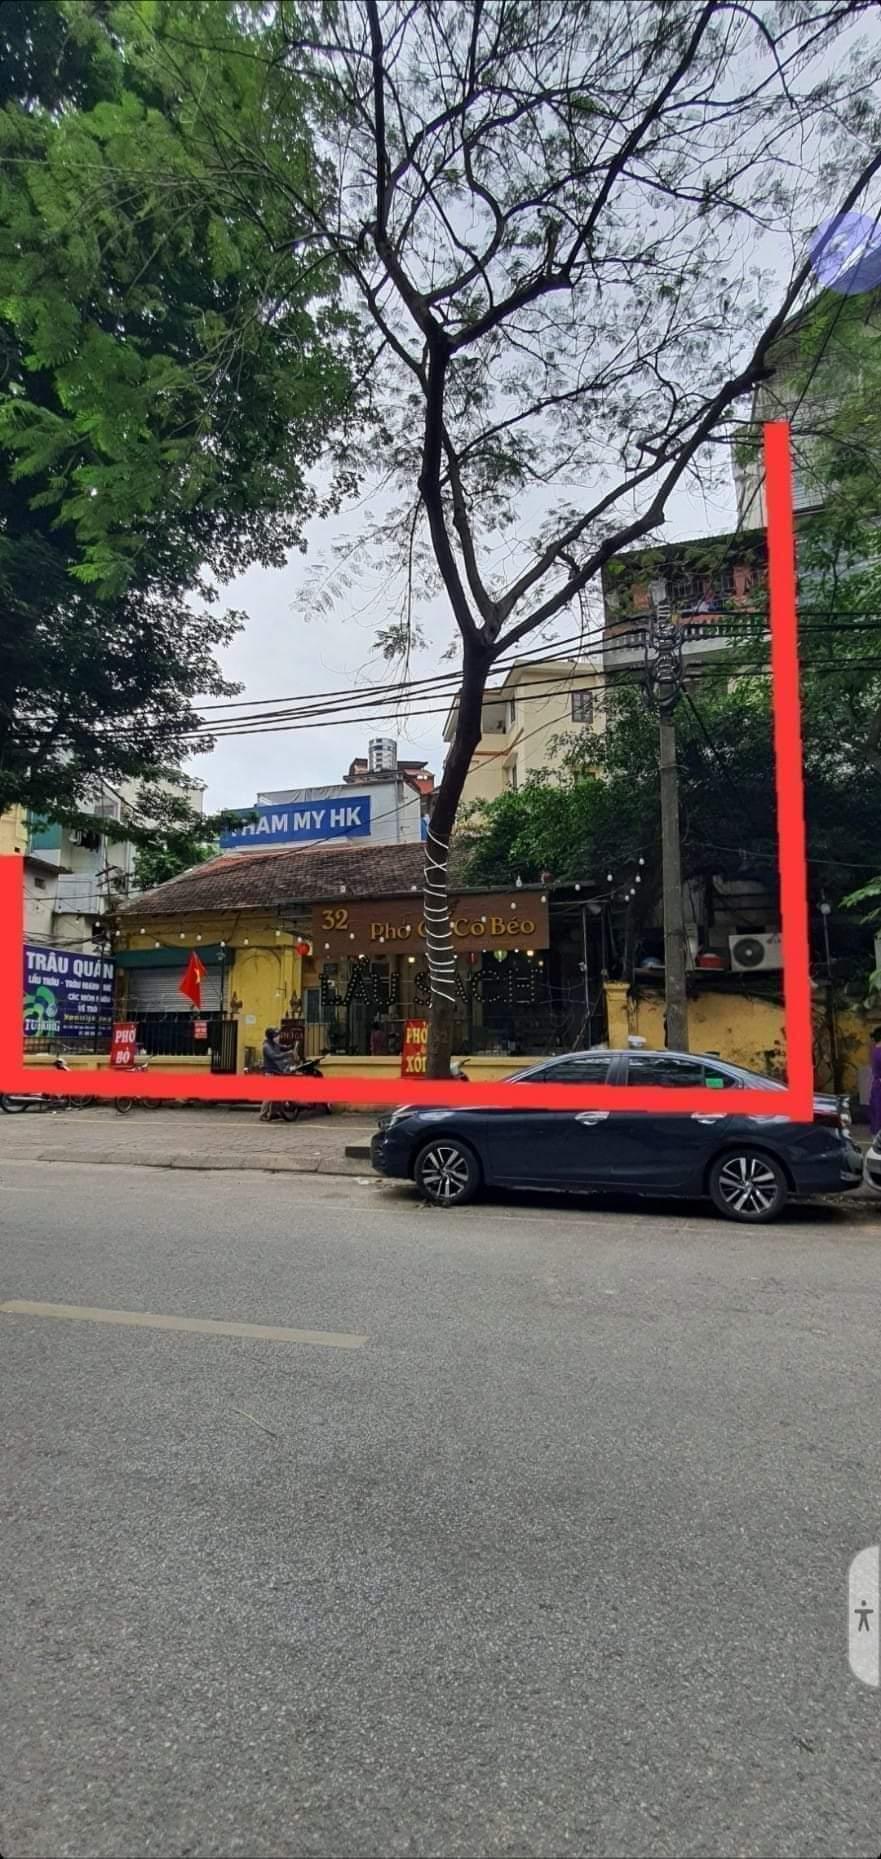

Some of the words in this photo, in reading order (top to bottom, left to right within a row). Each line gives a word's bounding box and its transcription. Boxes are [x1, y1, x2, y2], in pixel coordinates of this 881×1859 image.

[231, 814, 289, 837] HAM
[329, 806, 362, 828] HK
[322, 908, 349, 931] 32
[489, 916, 536, 936] Béo
[26, 951, 69, 974] TRÂU
[73, 959, 114, 979] QUÁN
[115, 1024, 136, 1043] PHỞ
